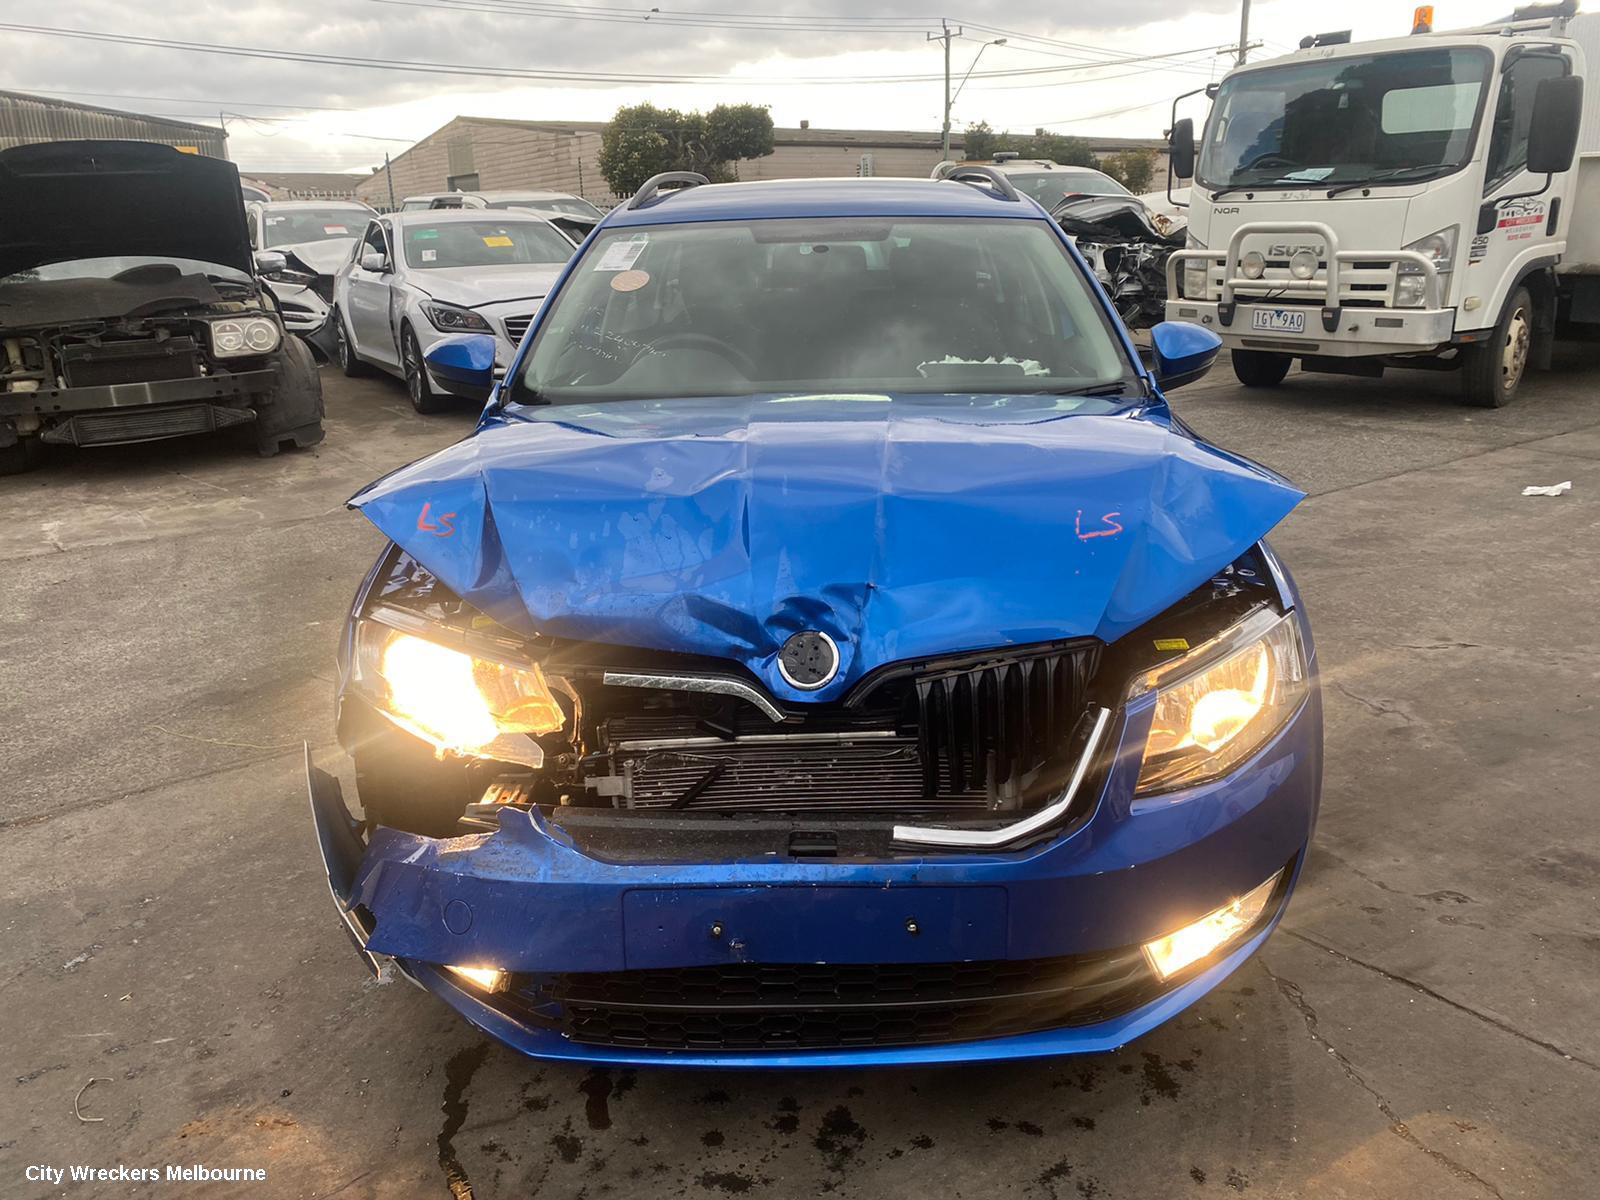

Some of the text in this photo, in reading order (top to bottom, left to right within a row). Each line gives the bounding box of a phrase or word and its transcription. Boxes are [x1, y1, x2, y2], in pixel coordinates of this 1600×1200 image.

[1472, 236, 1489, 245] 450
[418, 503, 457, 538] LS
[1075, 510, 1123, 540] LS
